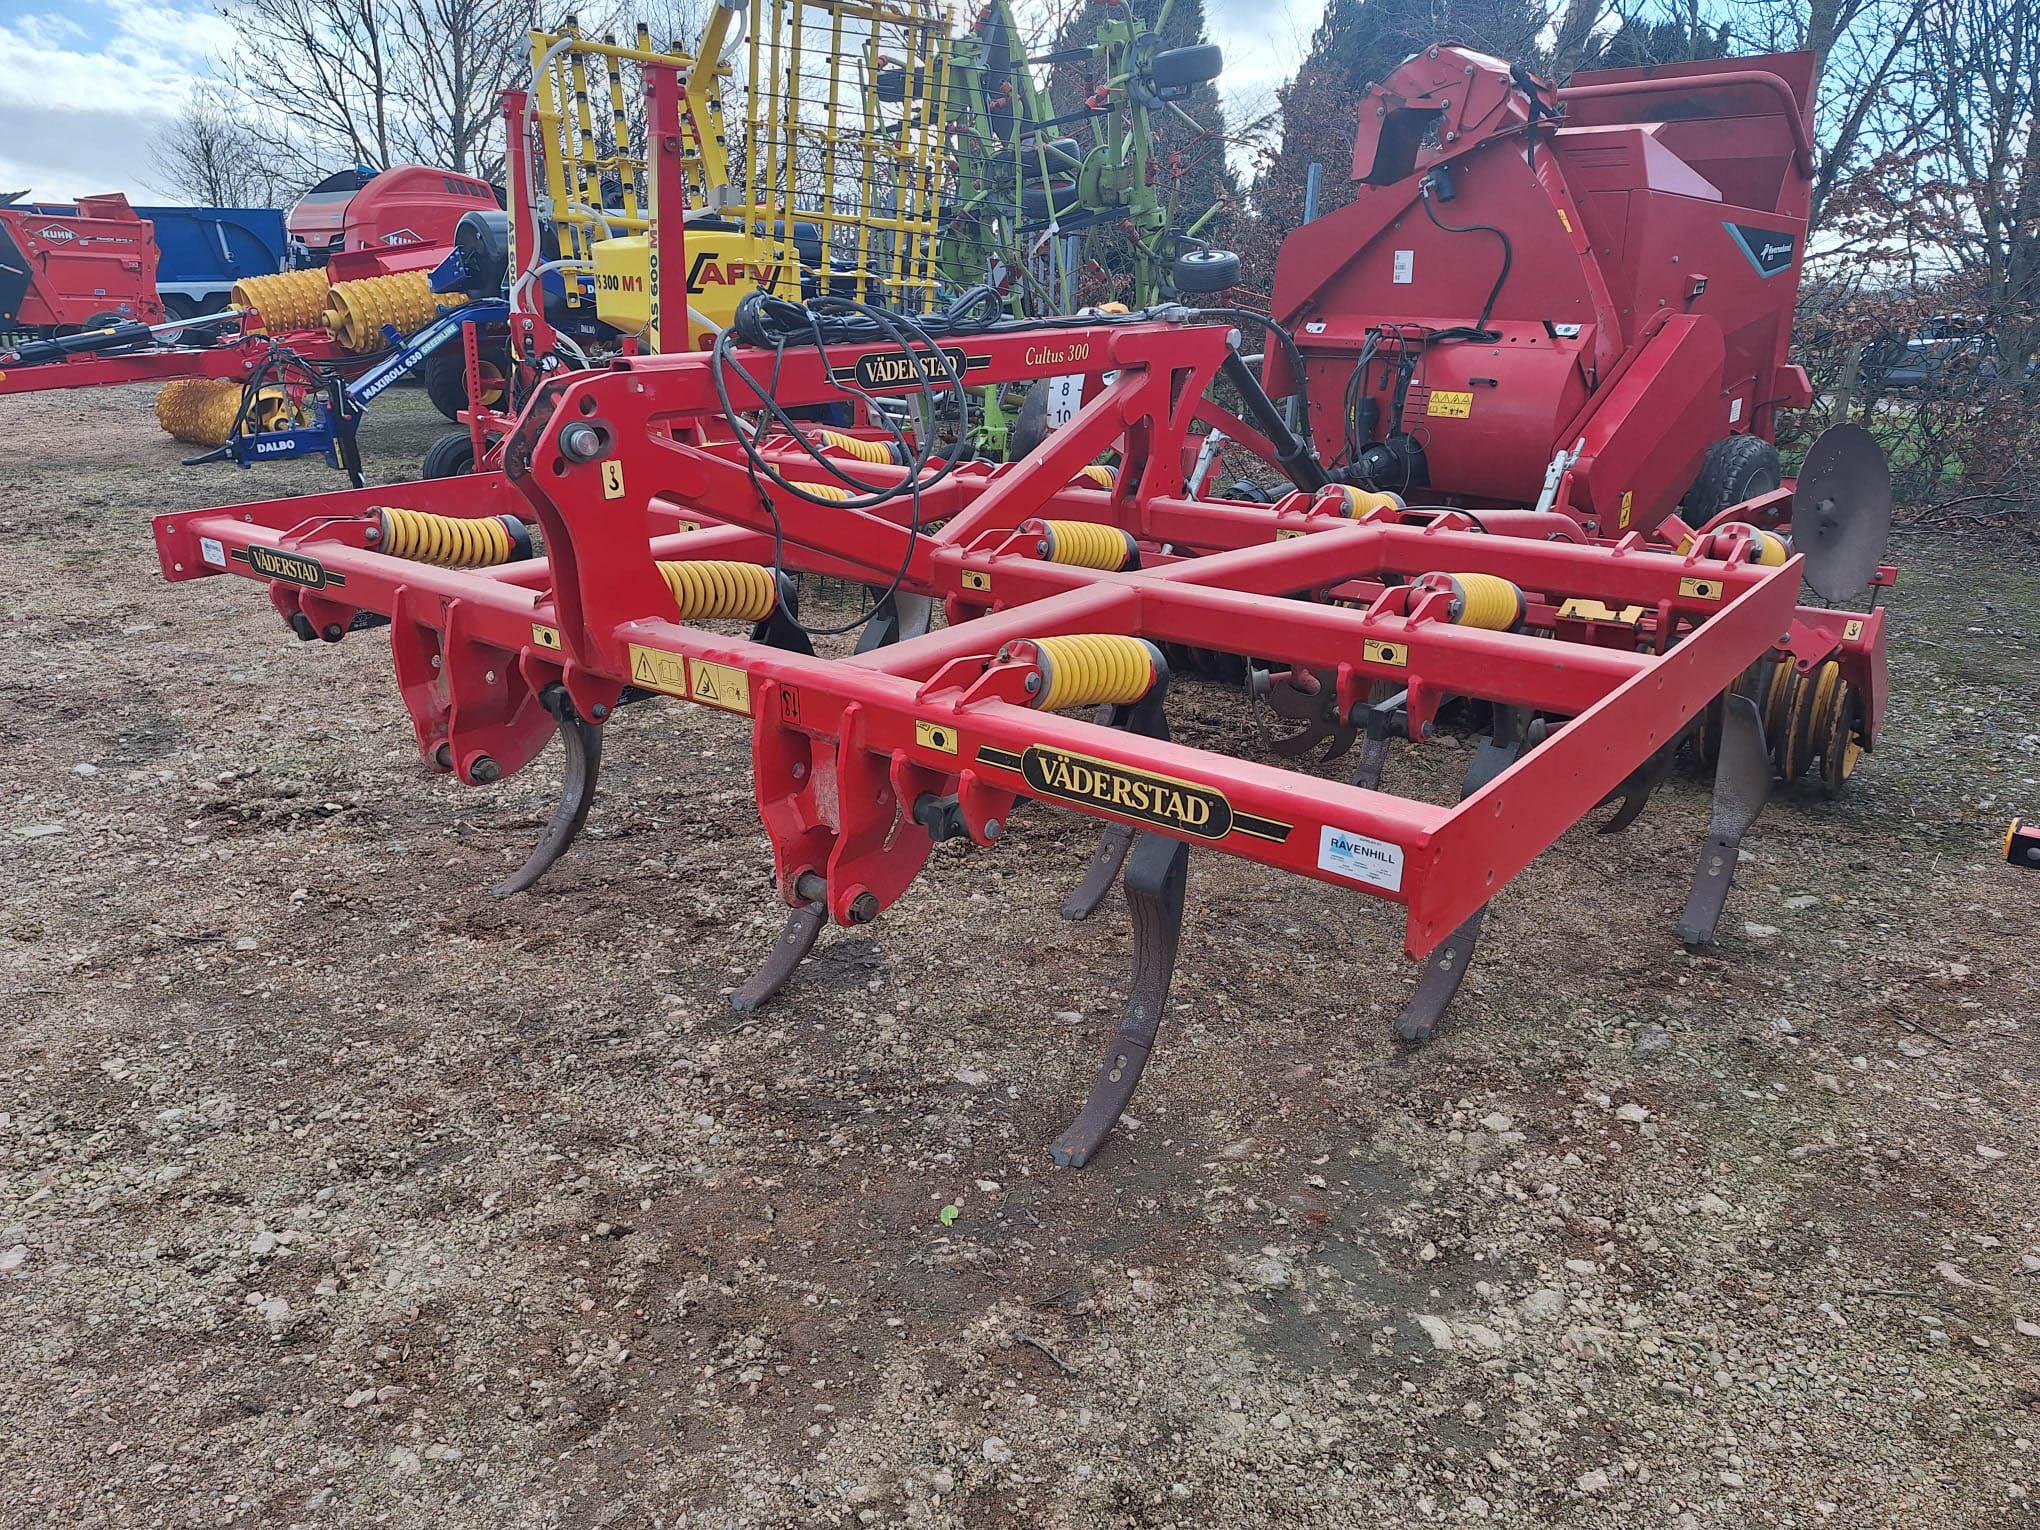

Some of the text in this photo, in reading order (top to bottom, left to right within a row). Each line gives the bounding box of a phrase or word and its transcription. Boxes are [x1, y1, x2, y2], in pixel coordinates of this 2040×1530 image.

[42, 230, 73, 239] KUHN
[508, 220, 516, 246] AS
[602, 274, 619, 291] 300
[622, 275, 643, 293] M1
[649, 218, 659, 332] AS 600 M1
[1025, 343, 1090, 366] Cultus 300
[362, 364, 408, 400] MAXIROLL
[404, 351, 423, 368] 630
[1061, 382, 1070, 397] 8
[1056, 409, 1071, 423] 10
[256, 440, 295, 453] DALBO
[253, 549, 319, 583] VÄDERSTAD
[1038, 755, 1210, 825] VÄDERSTAD
[1331, 838, 1395, 864] RAVENHILL
